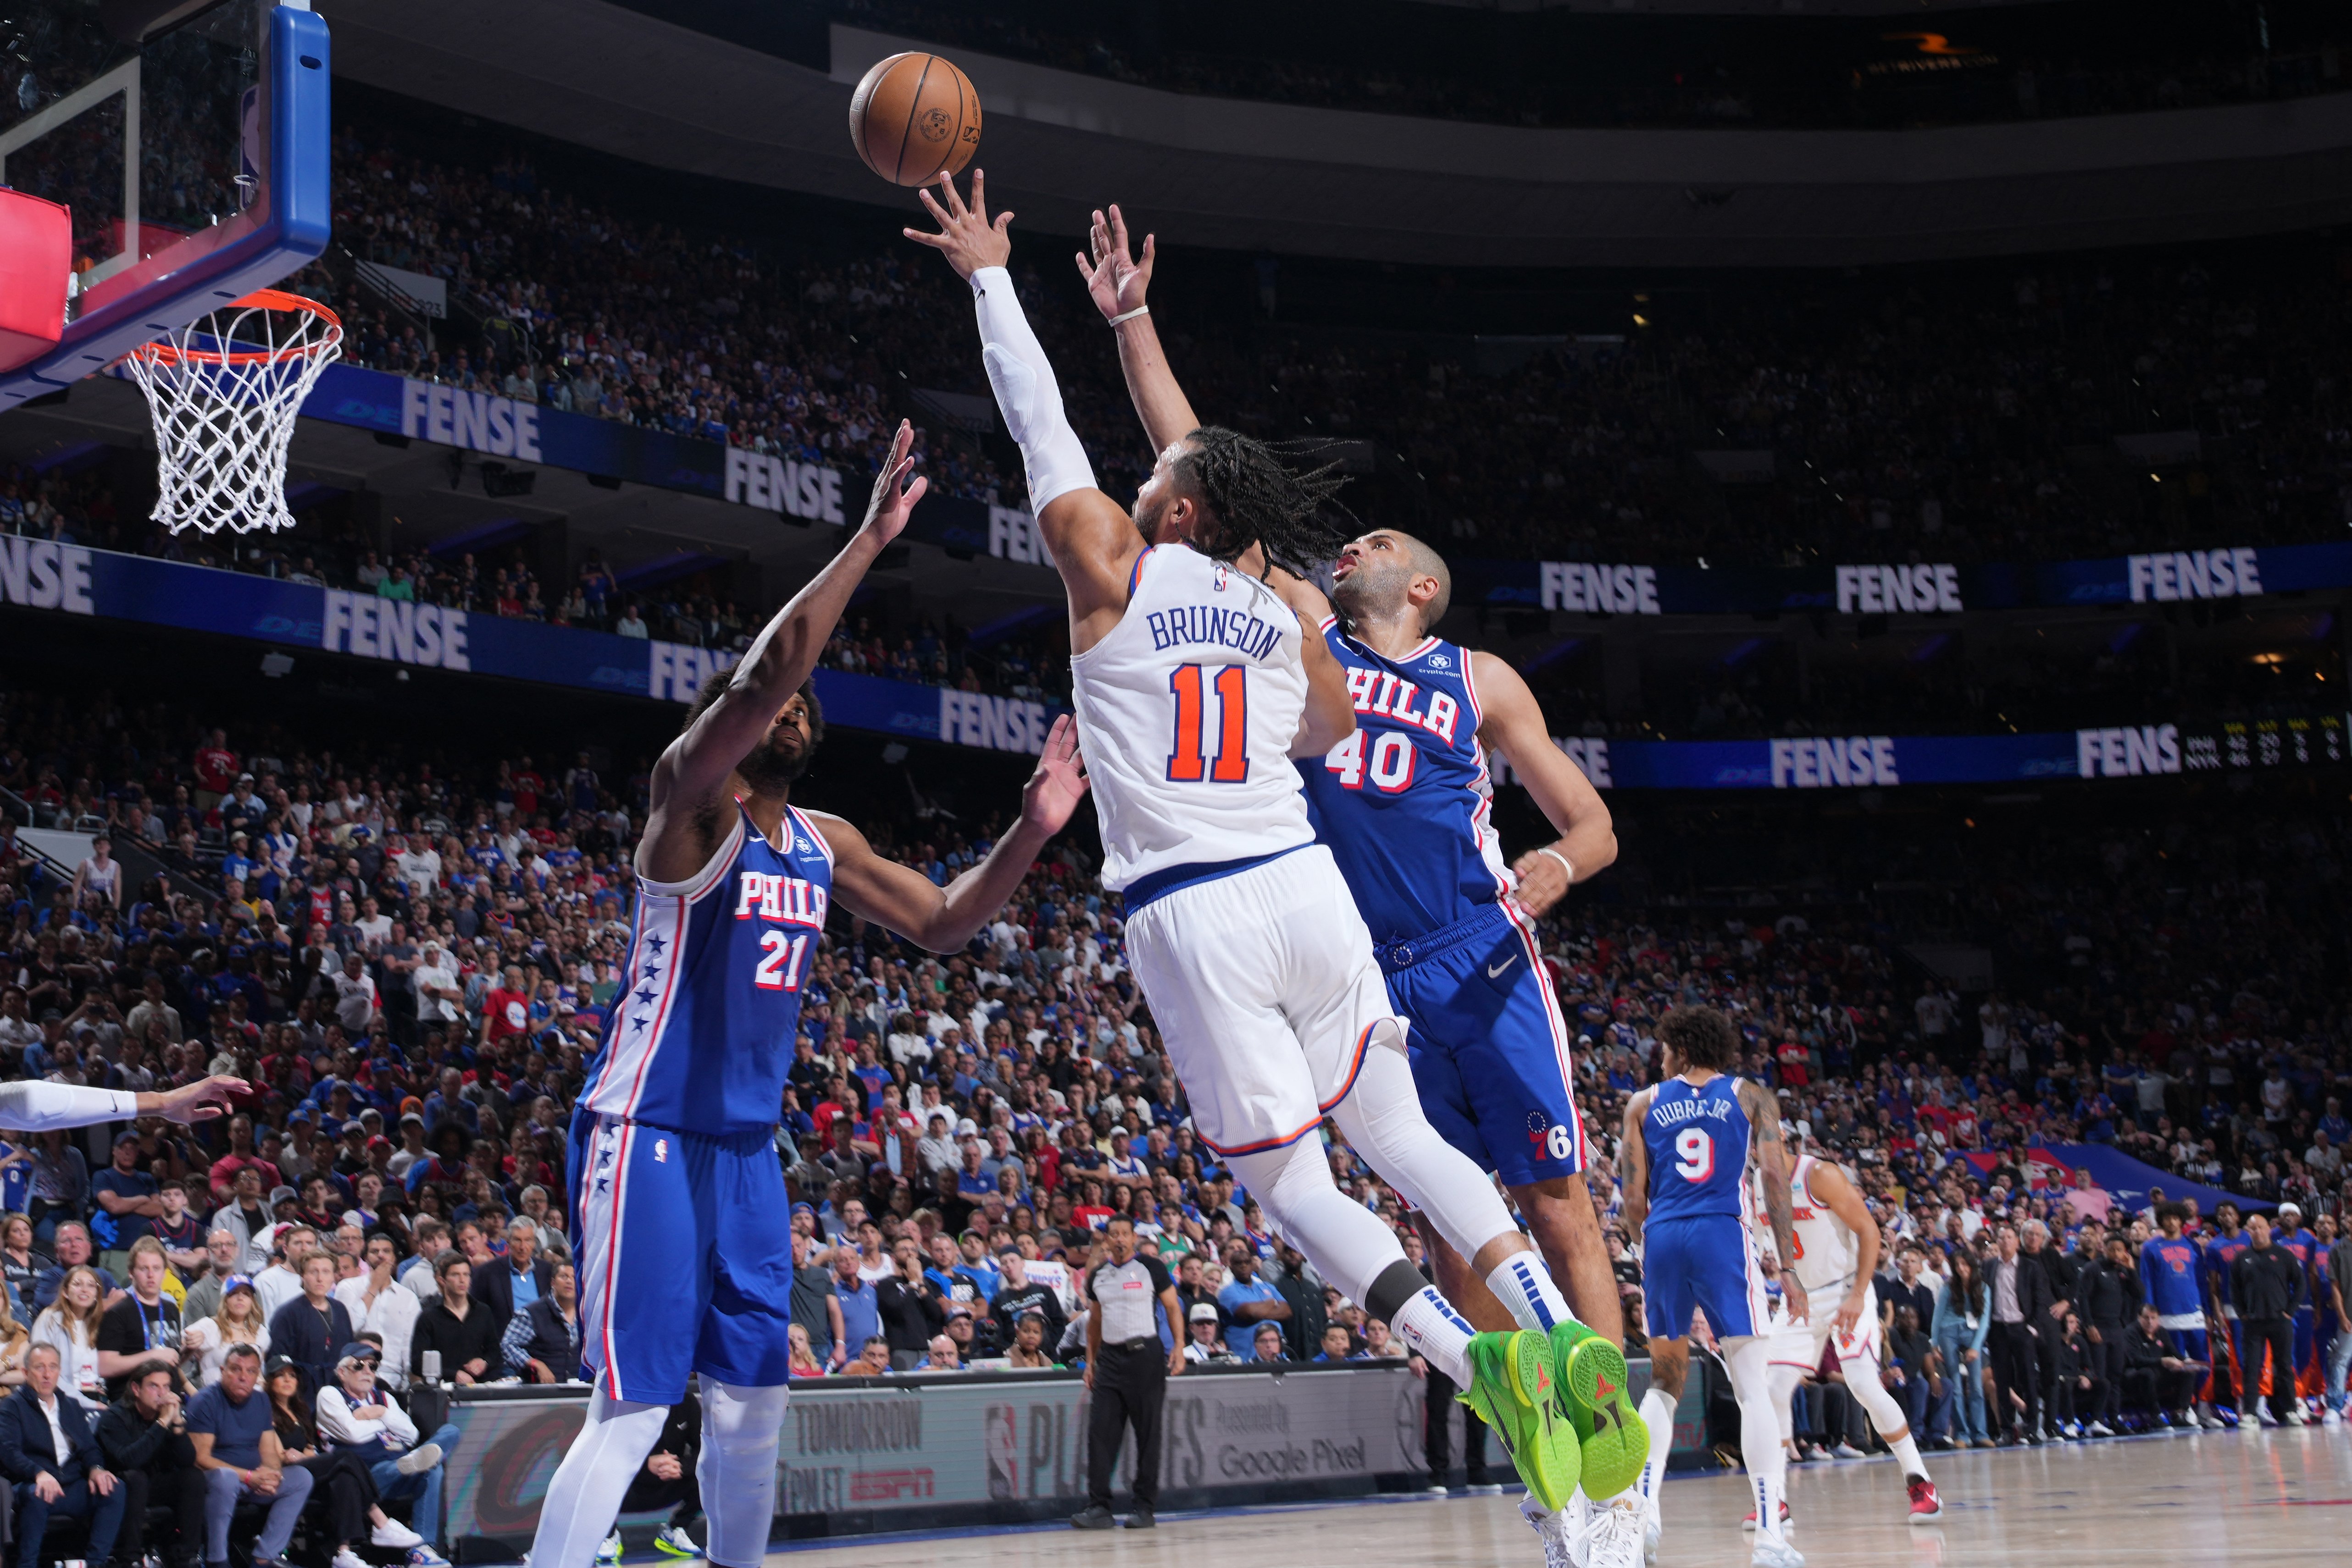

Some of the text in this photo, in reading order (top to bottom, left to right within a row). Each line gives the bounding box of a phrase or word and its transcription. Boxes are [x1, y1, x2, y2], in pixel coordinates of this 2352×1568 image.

[402, 376, 543, 463] FENSE
[725, 446, 846, 526] FENSE
[1540, 561, 1661, 615] FENSE
[1836, 563, 1964, 614] FENSE
[2128, 547, 2264, 603] FENSE
[322, 587, 471, 672] FENSE
[1146, 605, 1282, 661] BRUNSON
[649, 639, 744, 704] FEN
[1419, 668, 1461, 678] crypto.com
[939, 688, 1046, 756] FENSE
[1166, 663, 1249, 783] 11
[1346, 666, 1459, 748] HILA
[1325, 728, 1416, 794] 40
[1770, 736, 1900, 789] FENSE
[2076, 723, 2182, 779] FENS
[2184, 752, 2224, 770] NYK
[735, 872, 827, 932] PHILA
[754, 930, 808, 992] 21
[1652, 1097, 1733, 1128] OUBRE JR
[1528, 1124, 1573, 1160] 76
[1675, 1127, 1714, 1183] 9
[794, 1399, 922, 1455] TOMORROW
[849, 1468, 934, 1501] ESPN
[1217, 1435, 1365, 1481] Google Pixel
